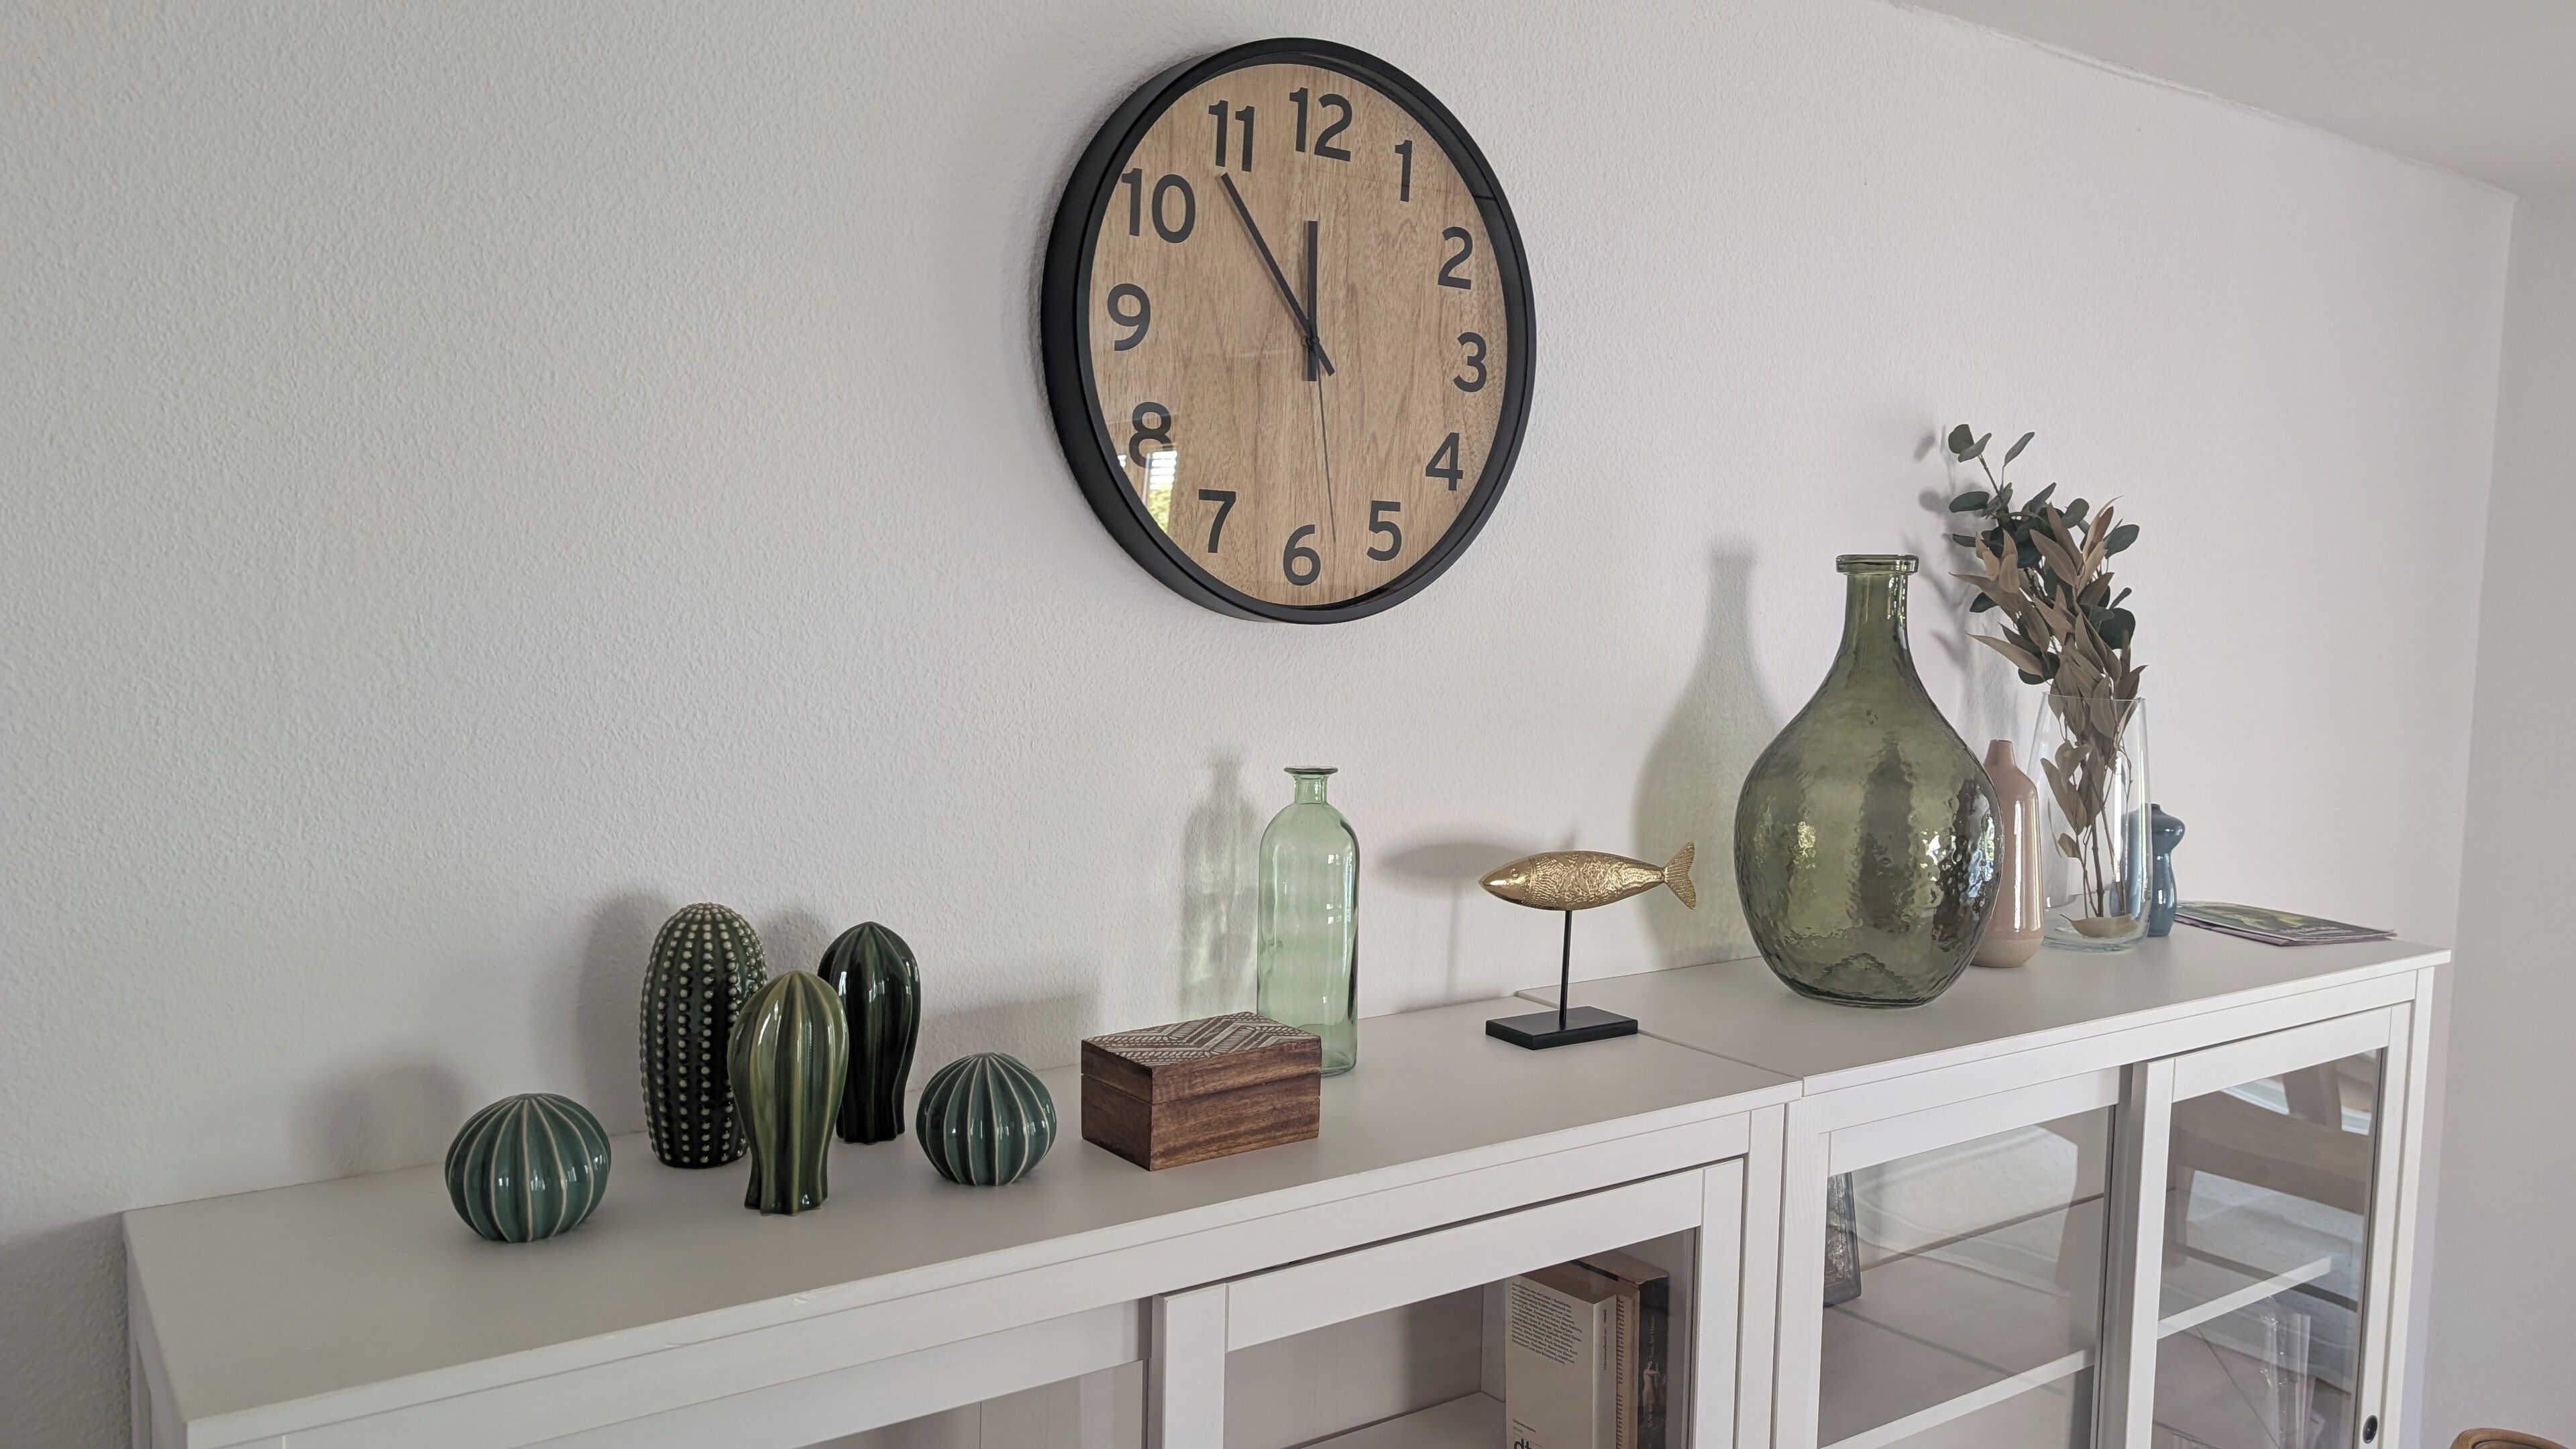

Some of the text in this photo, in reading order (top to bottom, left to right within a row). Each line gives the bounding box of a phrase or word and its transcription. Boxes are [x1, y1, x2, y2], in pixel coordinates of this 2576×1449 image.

[1209, 100, 1254, 172] 11
[1289, 87, 1352, 162] 12
[1395, 140, 1413, 202] 1
[1121, 168, 1196, 244] 10
[1438, 227, 1473, 290] 2
[1107, 283, 1150, 352] 9
[1453, 332, 1487, 392] 3
[1129, 402, 1172, 468] 8
[1426, 433, 1463, 490] 4
[1198, 489, 1236, 553] 7
[1366, 500, 1401, 561] 5
[1283, 525, 1320, 586] 6
